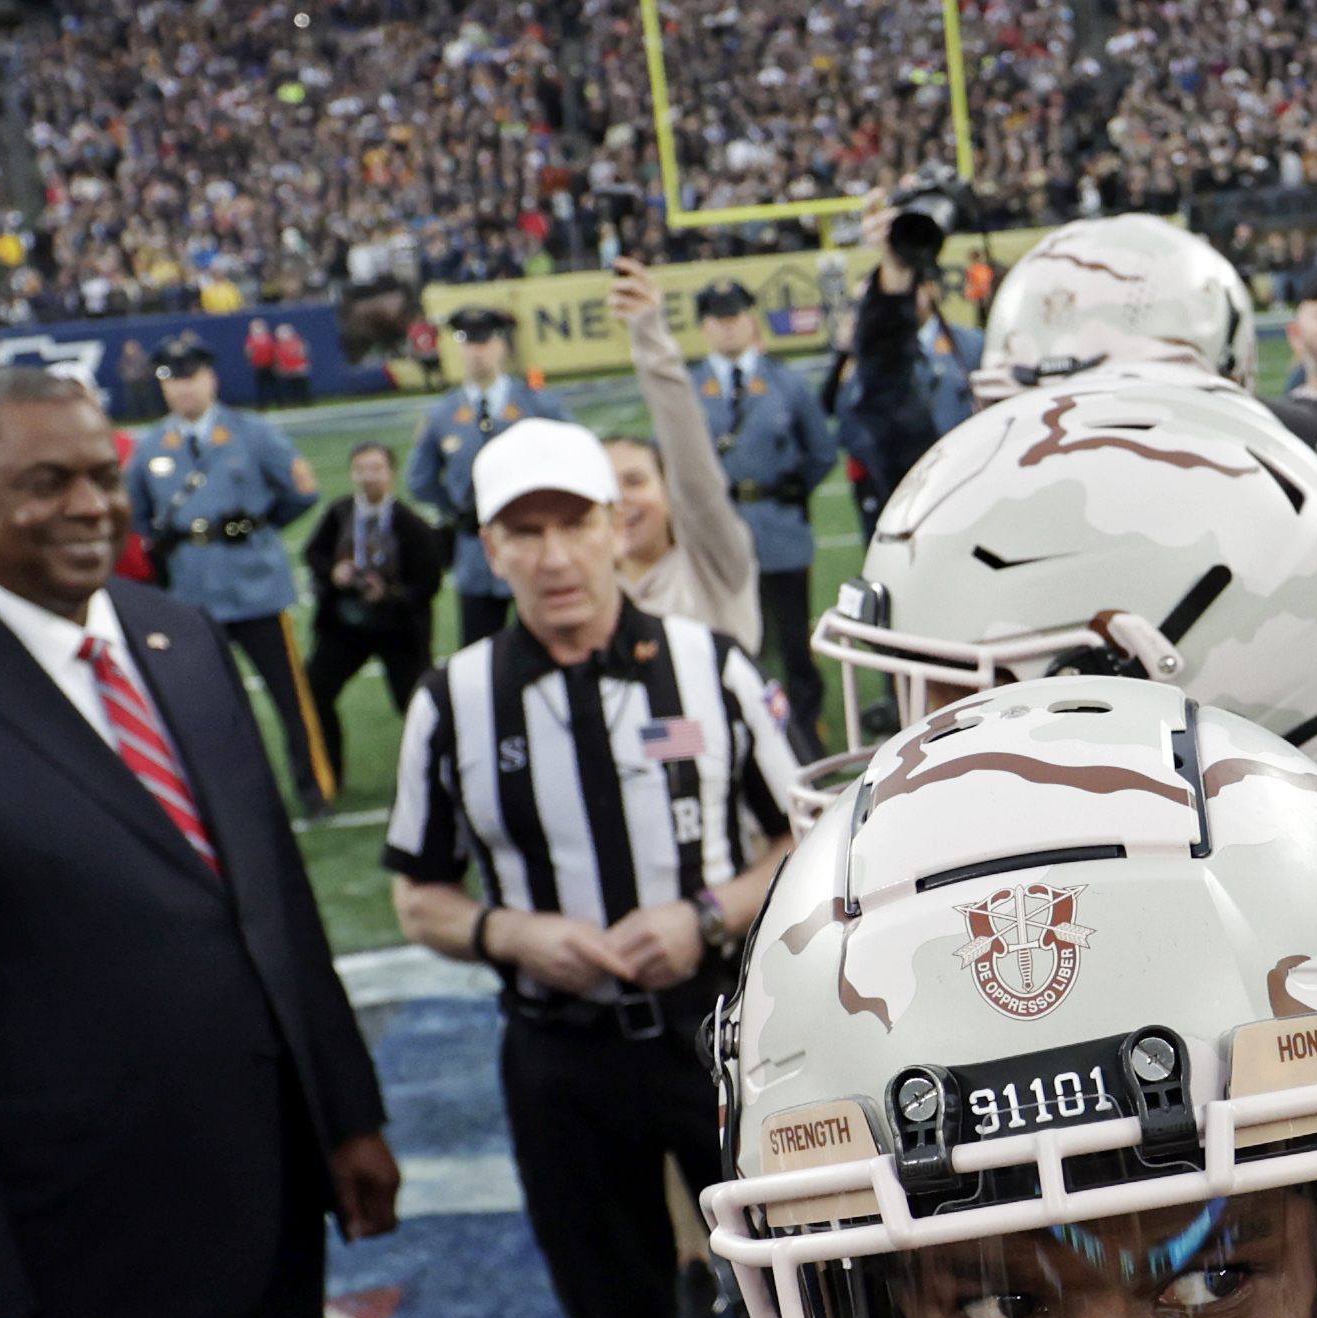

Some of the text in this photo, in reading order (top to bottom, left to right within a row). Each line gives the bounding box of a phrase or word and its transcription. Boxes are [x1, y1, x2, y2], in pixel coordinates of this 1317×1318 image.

[499, 736, 529, 773] S
[672, 797, 702, 844] R
[977, 948, 1075, 1014] DE OPPRESSO LIBER
[968, 1065, 1114, 1135] 91101
[769, 1118, 850, 1156] STRENGTH
